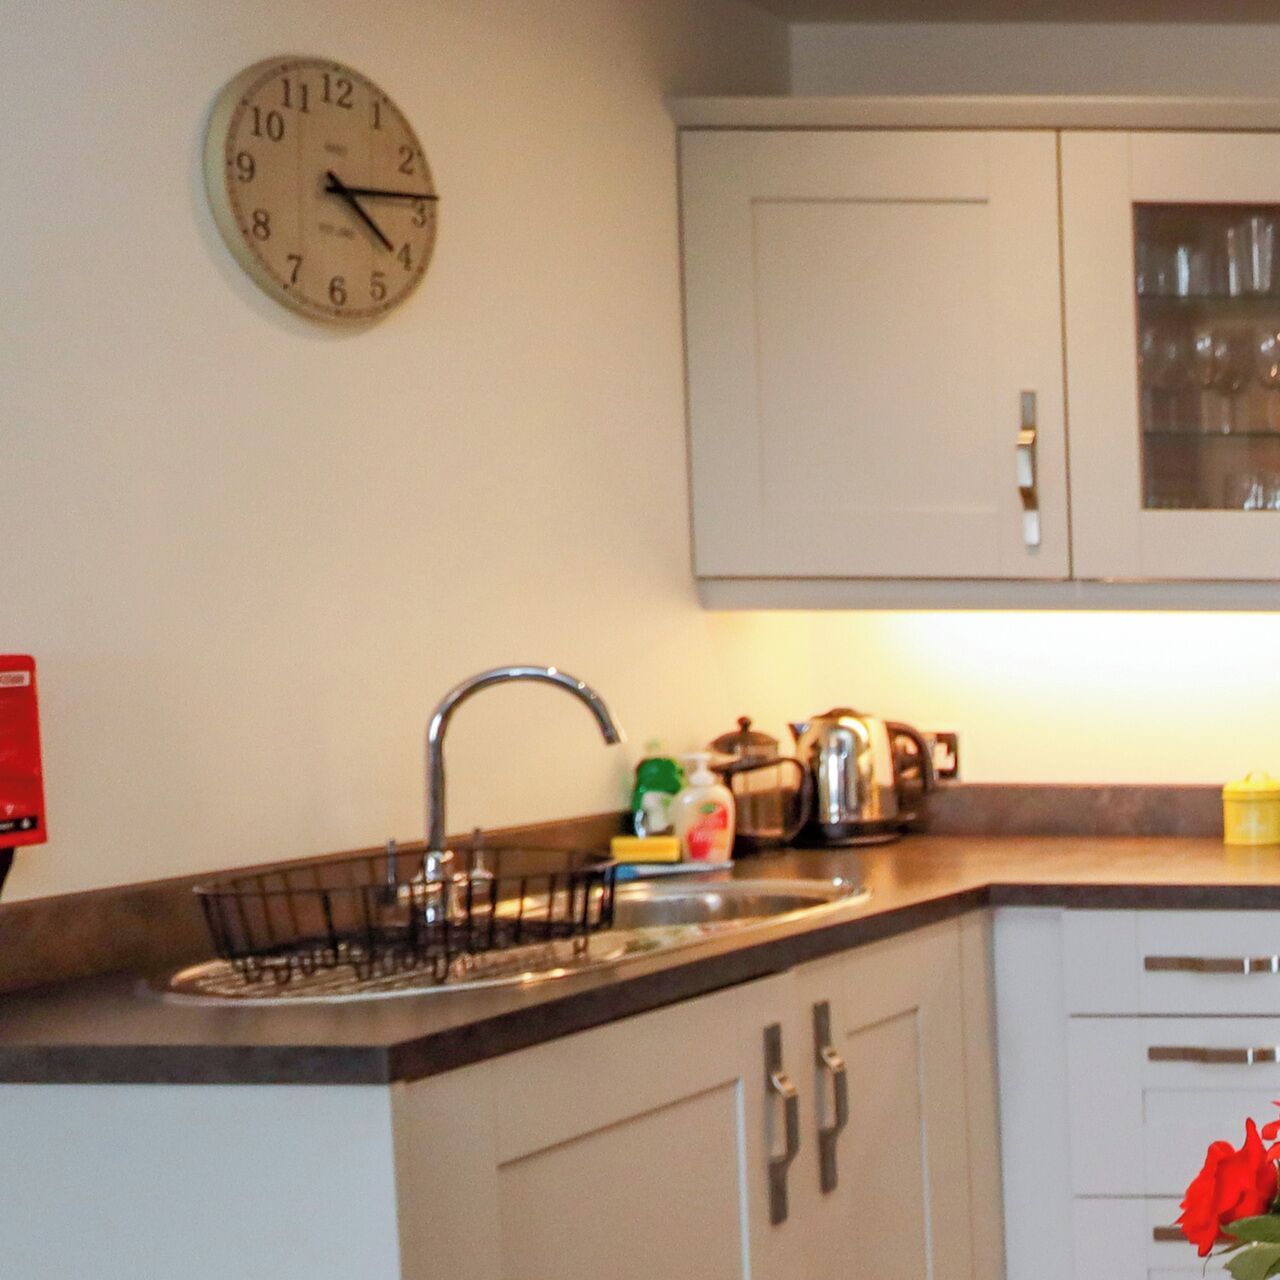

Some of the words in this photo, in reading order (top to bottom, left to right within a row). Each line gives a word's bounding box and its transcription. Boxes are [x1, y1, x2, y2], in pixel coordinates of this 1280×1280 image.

[281, 78, 310, 113] 11
[322, 74, 354, 109] 12
[251, 107, 284, 142] 10
[372, 101, 382, 130] 1
[236, 152, 256, 183] 9
[398, 146, 415, 175] 2
[252, 209, 272, 241] 8
[287, 254, 303, 285] 7
[397, 243, 412, 271] 4
[329, 276, 347, 306] 6
[370, 273, 387, 302] 5
